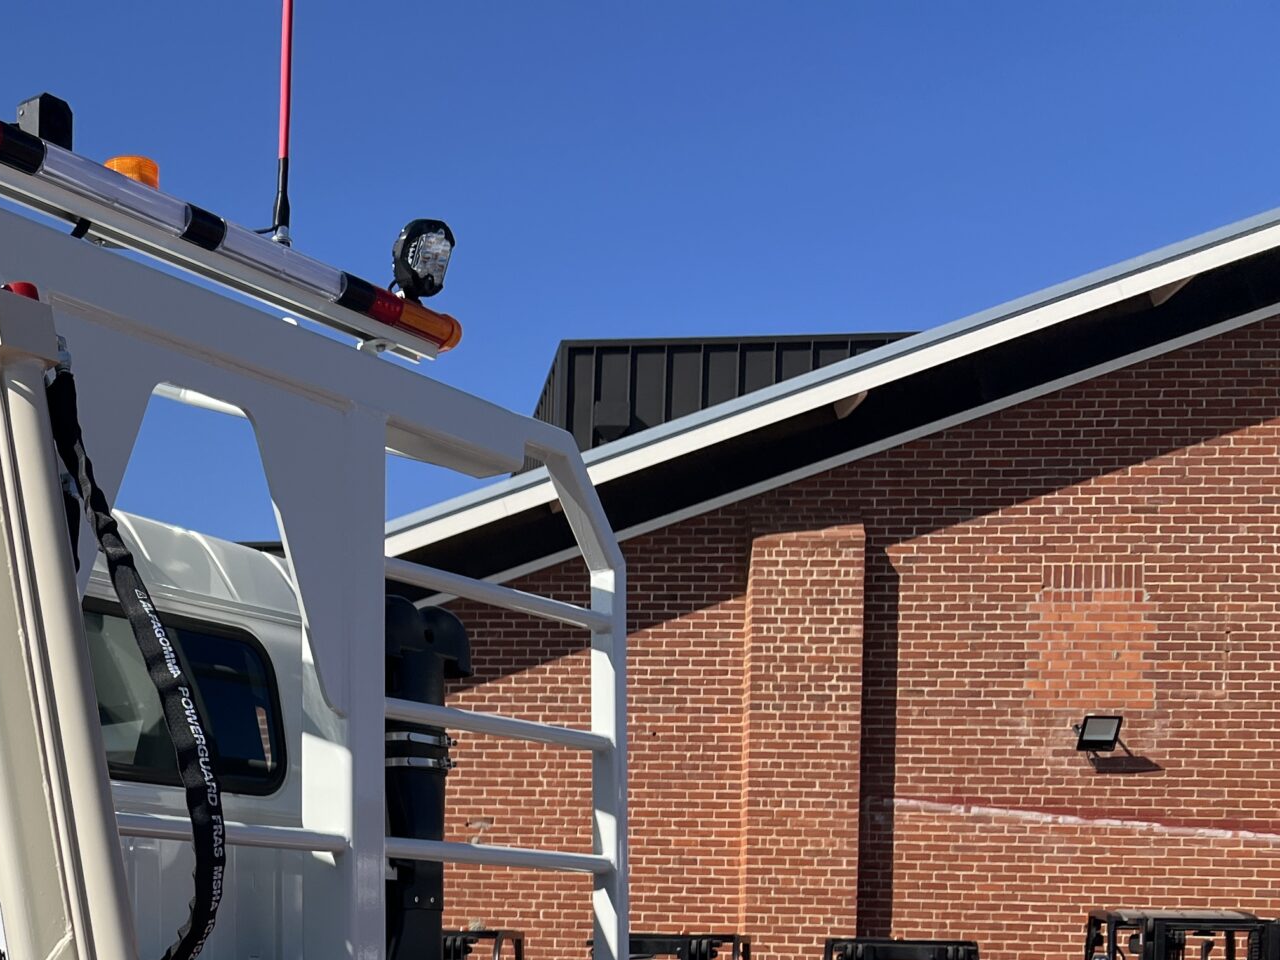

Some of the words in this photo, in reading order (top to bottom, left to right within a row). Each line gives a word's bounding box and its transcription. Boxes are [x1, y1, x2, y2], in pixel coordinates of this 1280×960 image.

[139, 599, 182, 679] ALFAGOMMA
[178, 685, 219, 807] POWERGUARD
[211, 814, 224, 859] FRAS
[209, 866, 223, 912] MSHA
